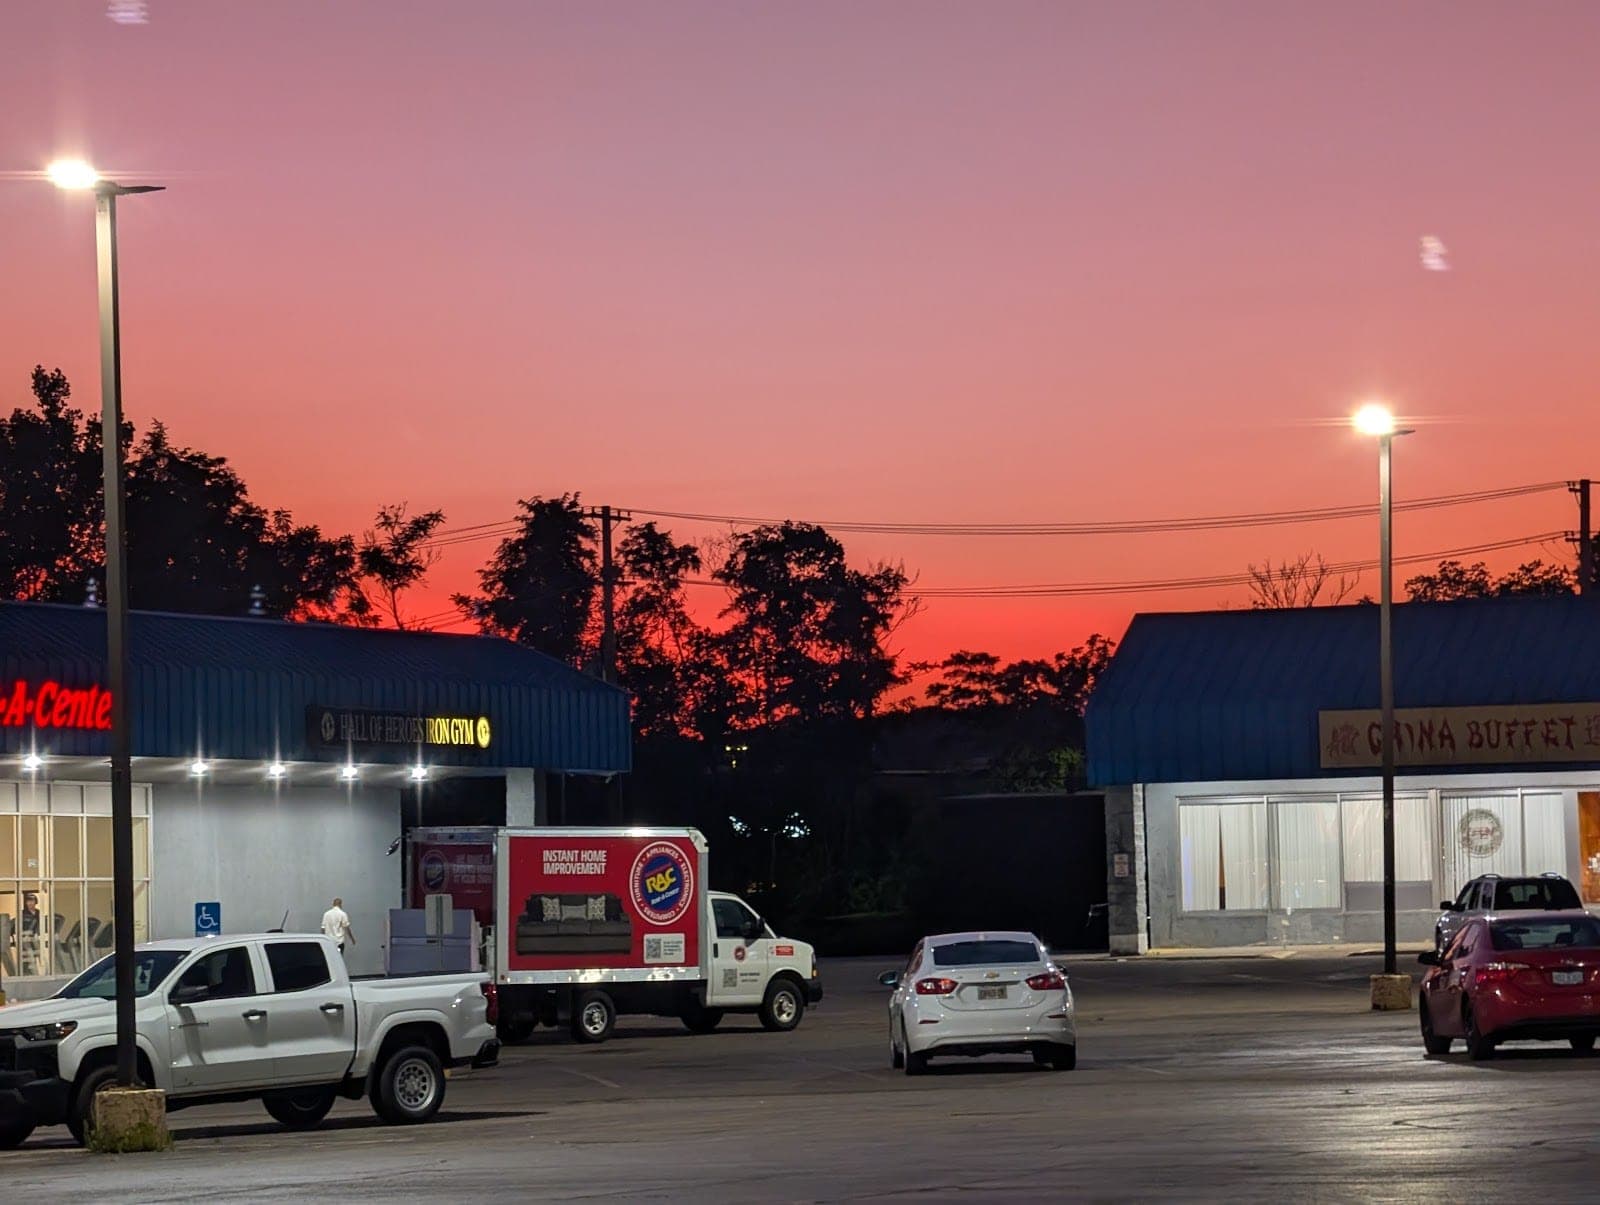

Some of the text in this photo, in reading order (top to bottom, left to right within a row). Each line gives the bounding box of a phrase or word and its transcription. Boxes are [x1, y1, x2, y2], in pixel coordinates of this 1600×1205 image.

[340, 713, 475, 745] HALL OF HEROES IRON GYM
[1466, 714, 1579, 751] BUFFET
[543, 849, 607, 862] INSTANT HOME
[645, 846, 680, 859] APPLIANCES
[543, 862, 607, 875] IMPROVEMENT
[634, 861, 644, 902] FURNITURE
[645, 867, 677, 894] RAC
[678, 862, 690, 908] ELECTRONICS
